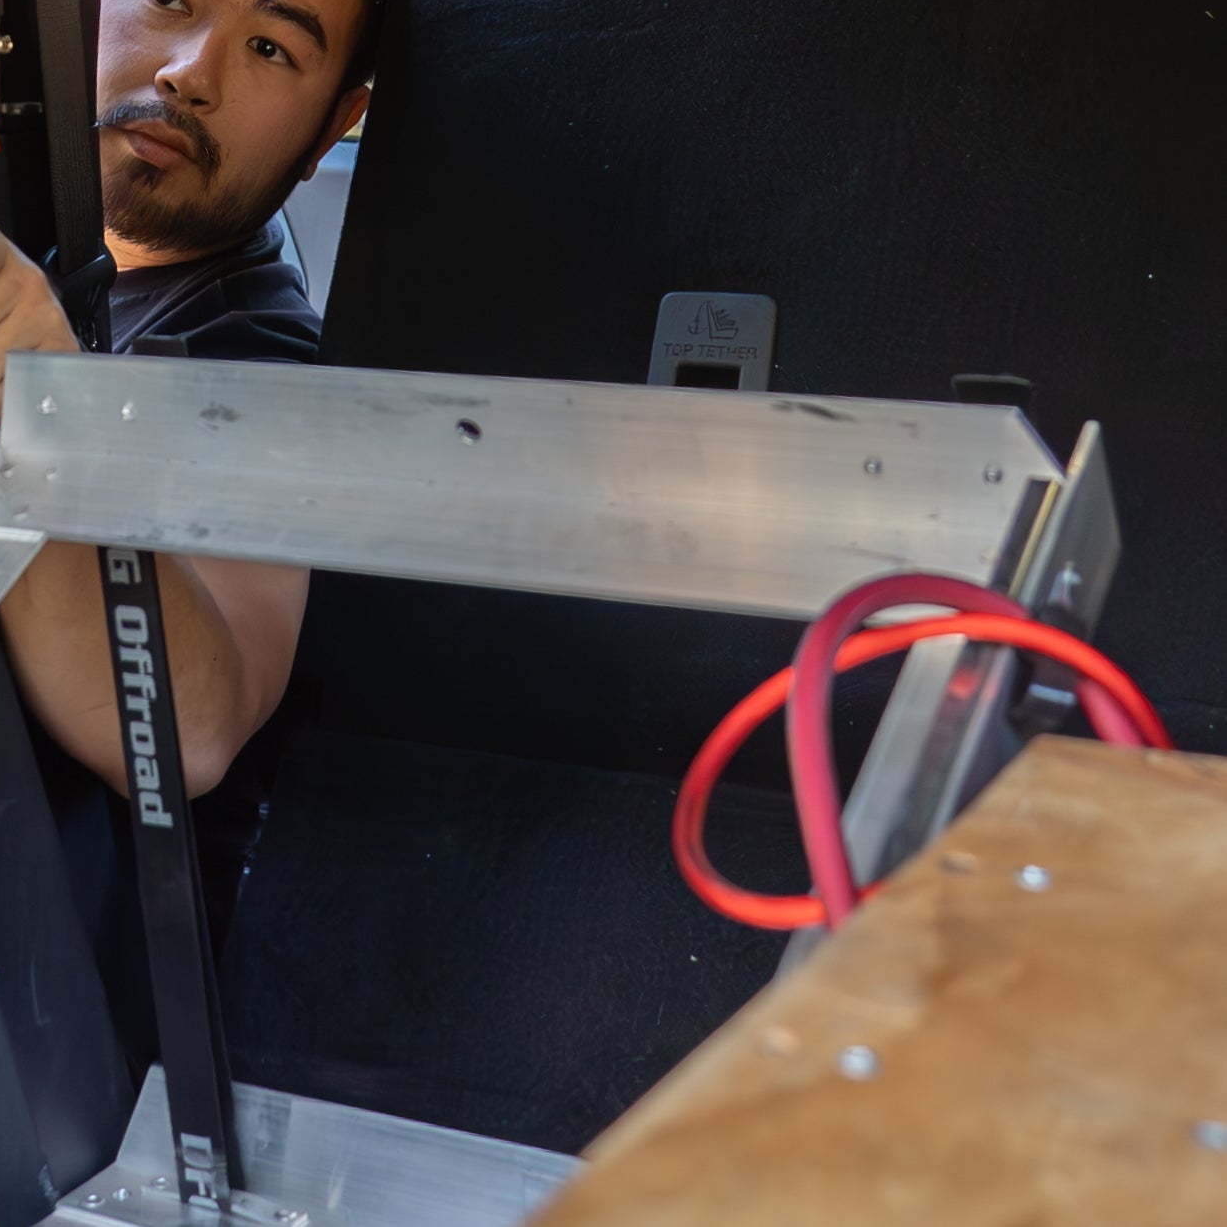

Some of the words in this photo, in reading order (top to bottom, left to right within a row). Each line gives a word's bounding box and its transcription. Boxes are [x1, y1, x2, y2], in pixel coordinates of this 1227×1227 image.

[663, 342, 693, 357] TOP
[698, 343, 758, 360] TETHER
[114, 604, 174, 828] Offroad
